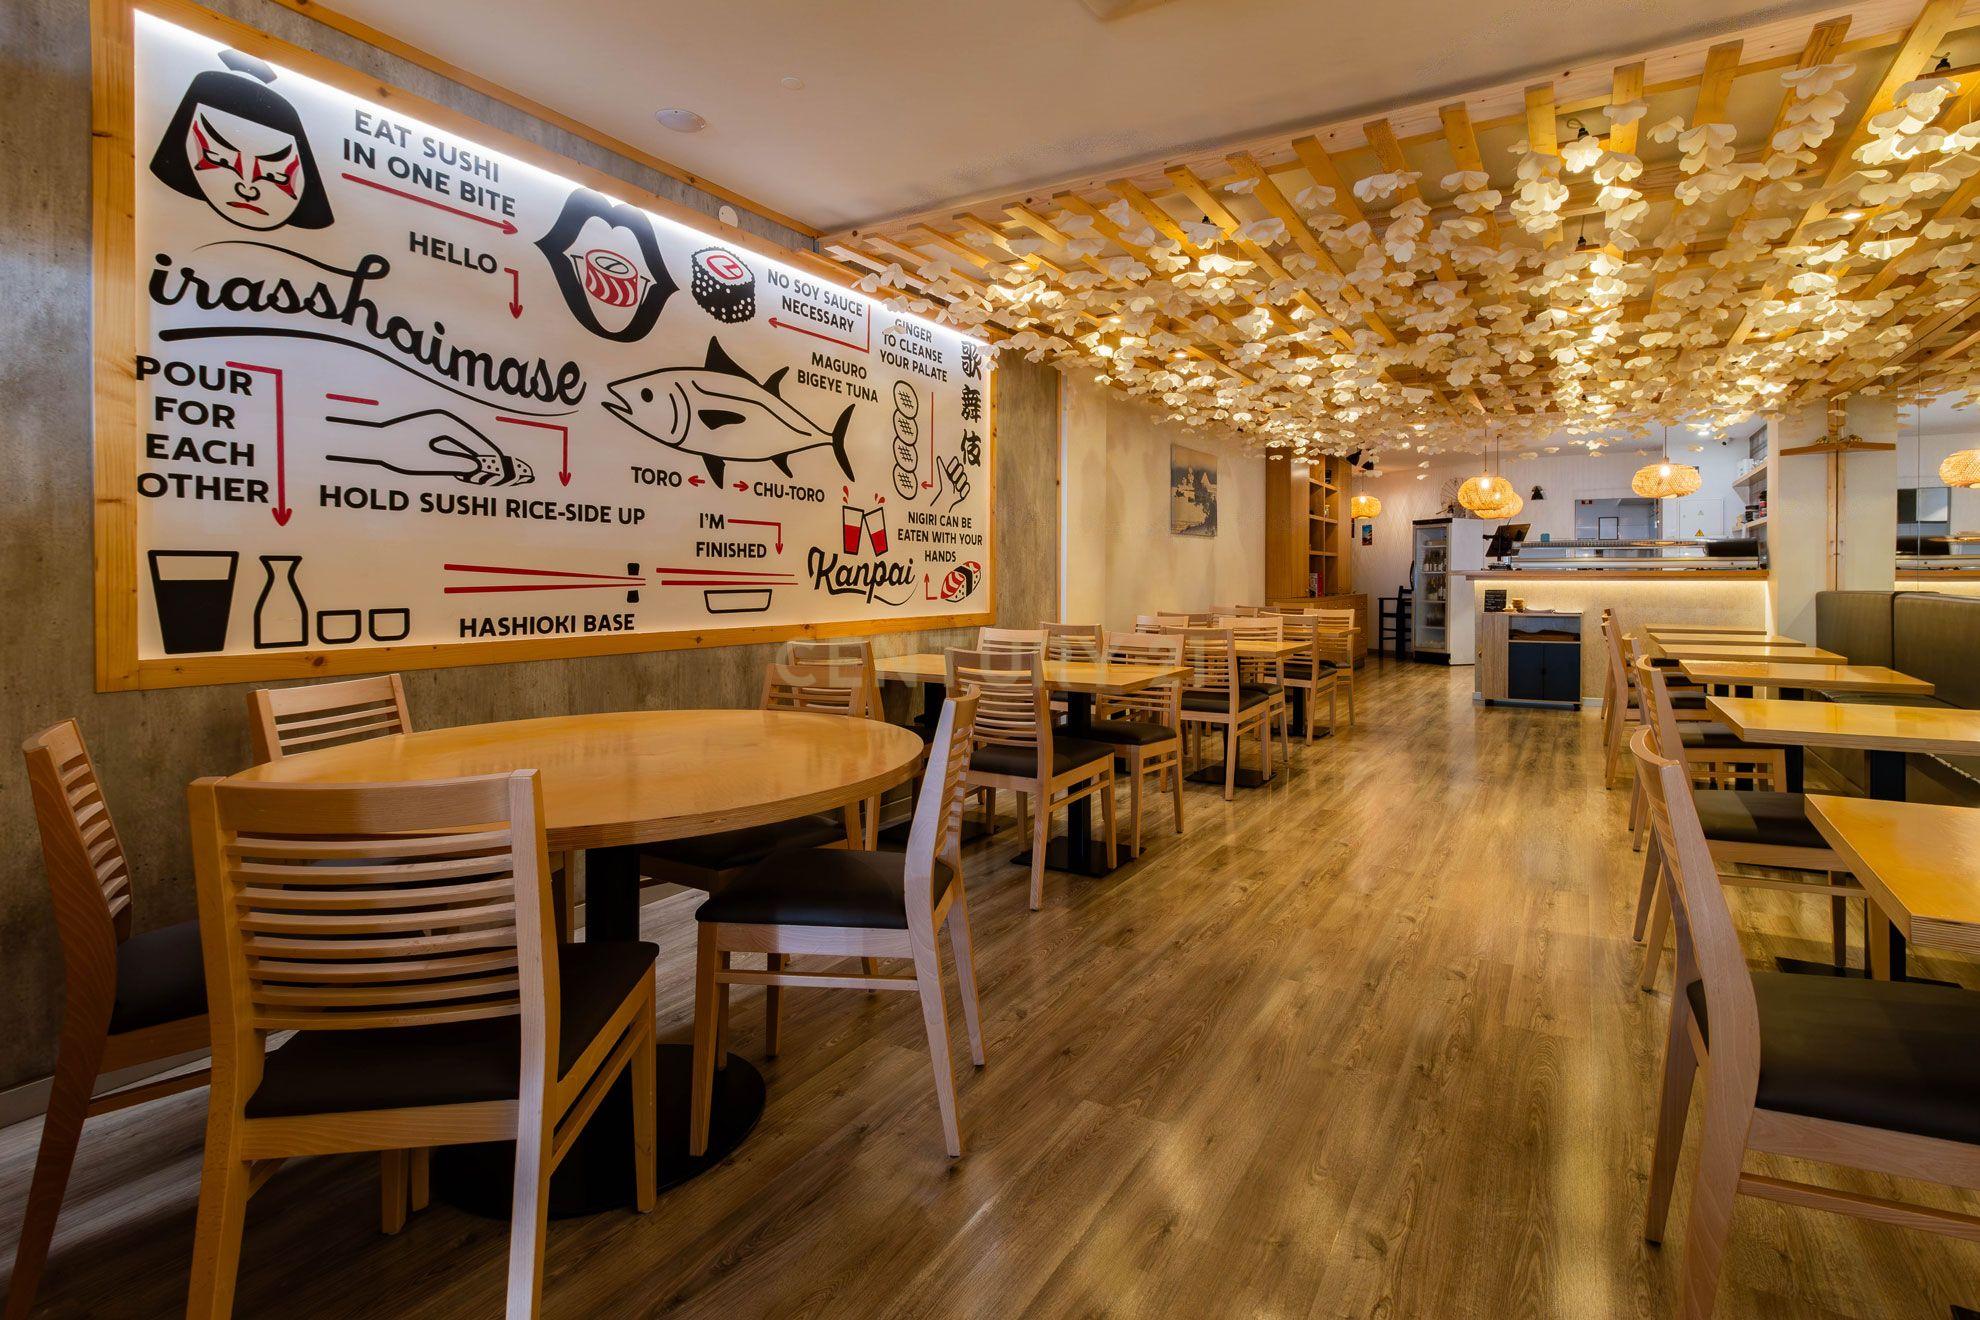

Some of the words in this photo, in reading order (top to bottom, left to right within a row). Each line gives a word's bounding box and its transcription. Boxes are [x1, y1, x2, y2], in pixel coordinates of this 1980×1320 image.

[356, 110, 411, 148] EAT
[423, 138, 498, 182] SUSHI
[344, 138, 375, 169] IN
[387, 157, 450, 196] ONE
[459, 180, 515, 220] BITE
[410, 231, 497, 274] HELLO
[768, 270, 789, 288] NO
[795, 280, 819, 300] SOY
[824, 291, 862, 317] SAUCE
[147, 253, 588, 406] irasshaimase
[782, 295, 855, 332] NECESSARY
[812, 352, 866, 379] MAGURO
[880, 349, 909, 370] YOUR
[912, 360, 947, 382] PALATE
[884, 334, 896, 347] TO
[899, 339, 943, 364] CLEANSE
[134, 355, 254, 396] POUR
[797, 369, 843, 396] BIGEYE
[846, 382, 878, 402] TUNA
[155, 396, 235, 429] FOR
[960, 340, 983, 468] 歌舞伎
[146, 433, 254, 467] EACH
[137, 473, 268, 503] OTHER
[631, 466, 682, 487] TORO
[754, 482, 825, 502] CHU-TORO
[320, 485, 409, 511] HOLD
[420, 492, 496, 516] SUSHI
[506, 499, 611, 523] RICE-SIDE
[619, 508, 645, 524] UP
[908, 512, 936, 526] NIGIRI
[940, 515, 958, 527] CAN
[962, 517, 972, 528] BE
[696, 542, 766, 558] FINISHED
[898, 528, 928, 542] EATEN
[932, 531, 956, 544] WITH
[959, 533, 982, 545] YOUR
[925, 550, 956, 562] HANDS
[807, 546, 916, 604] Kanpai
[460, 615, 576, 638] HASHIOKI
[584, 614, 634, 632] BASE
